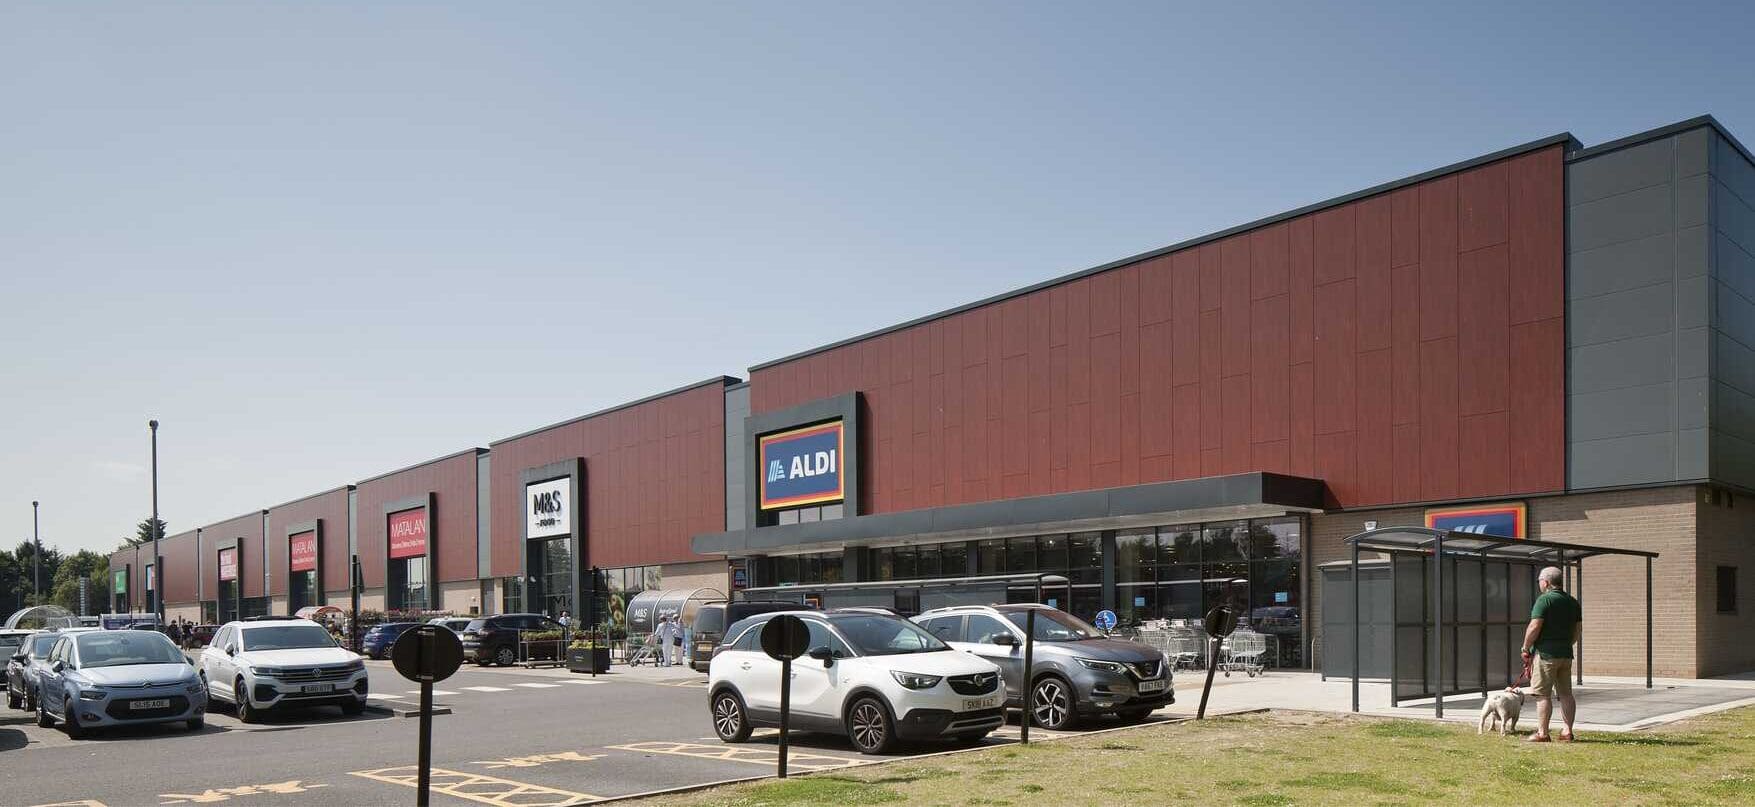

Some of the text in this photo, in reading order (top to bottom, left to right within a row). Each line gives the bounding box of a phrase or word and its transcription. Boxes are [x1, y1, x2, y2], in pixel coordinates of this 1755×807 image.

[789, 449, 836, 479] ALDI
[533, 490, 561, 515] M&S
[391, 518, 425, 537] MATALAN
[634, 608, 648, 618] M&S
